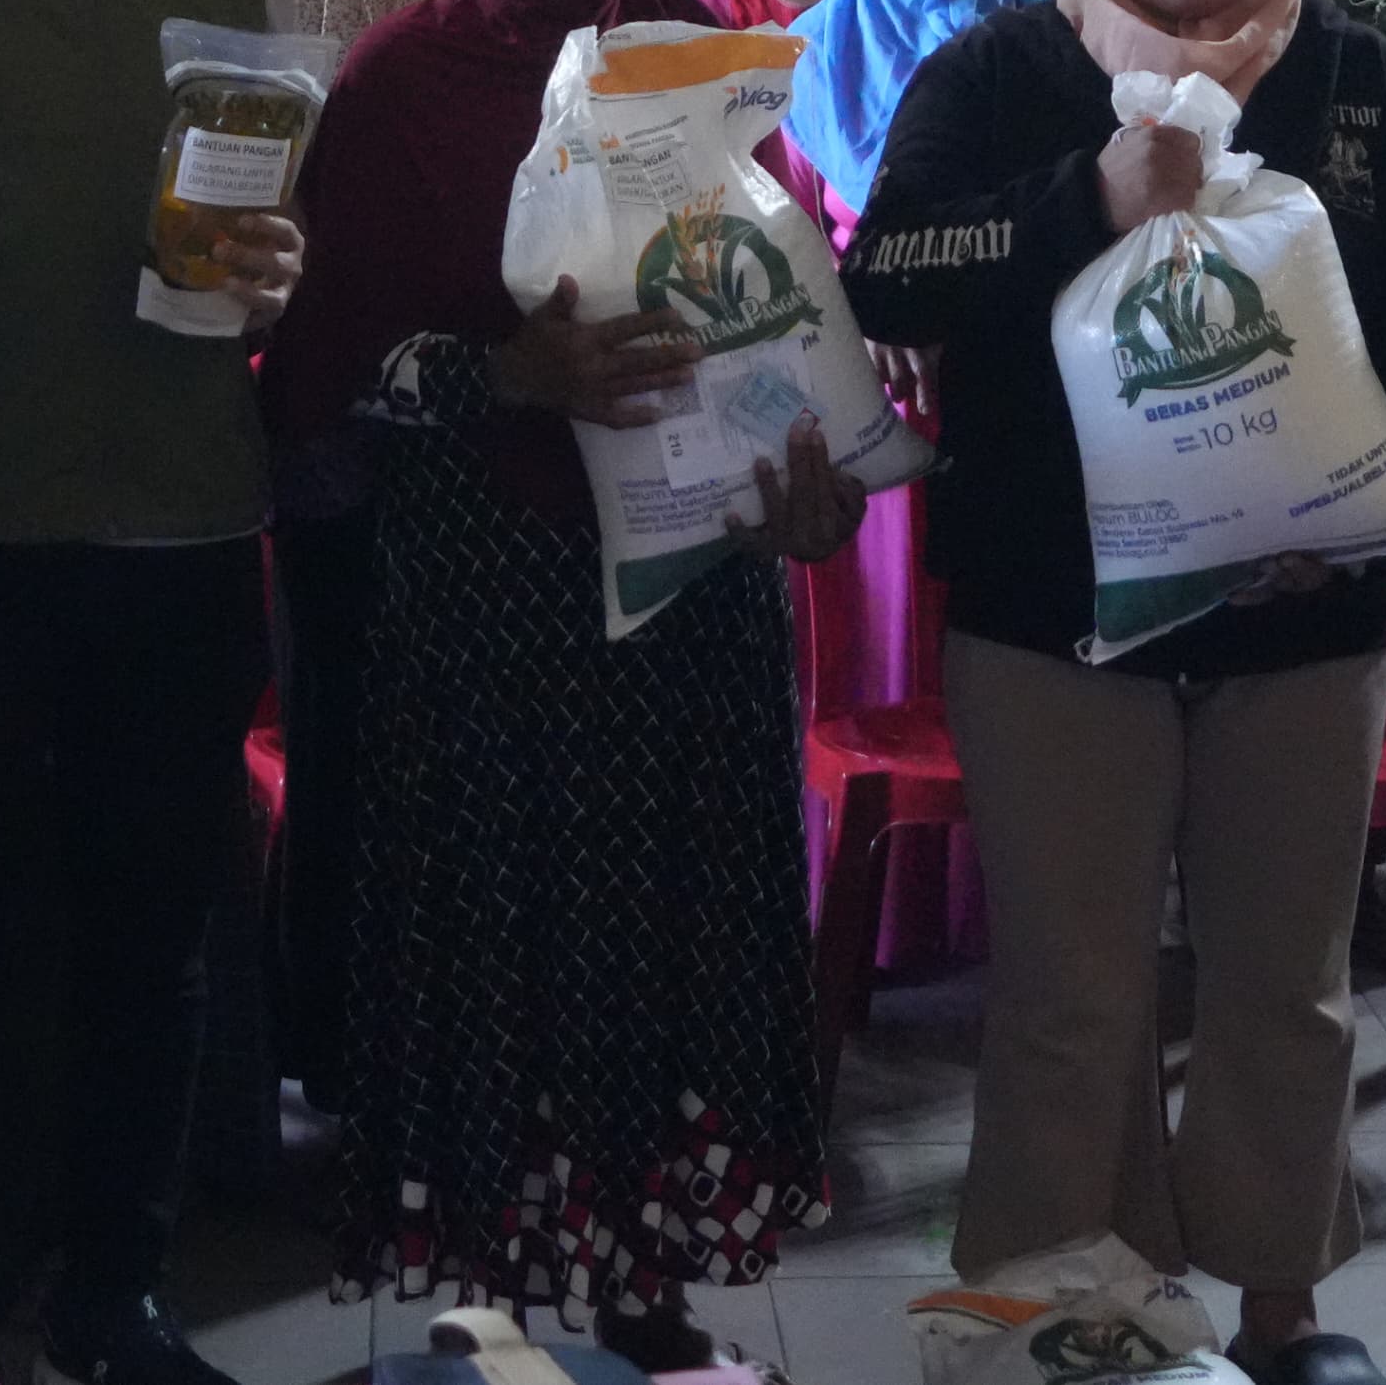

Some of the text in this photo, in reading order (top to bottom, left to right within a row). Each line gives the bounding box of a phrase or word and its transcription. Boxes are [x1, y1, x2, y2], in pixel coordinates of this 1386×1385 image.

[192, 136, 284, 157] BANTUAN PANGAN
[738, 281, 812, 331] PANGAN
[1114, 309, 1284, 380] BANTUAN PANGAN
[1145, 362, 1291, 423] BERAS MEDIUM
[1199, 422, 1234, 450] 10
[1241, 407, 1279, 435] kg
[1325, 456, 1365, 484] TIDAK
